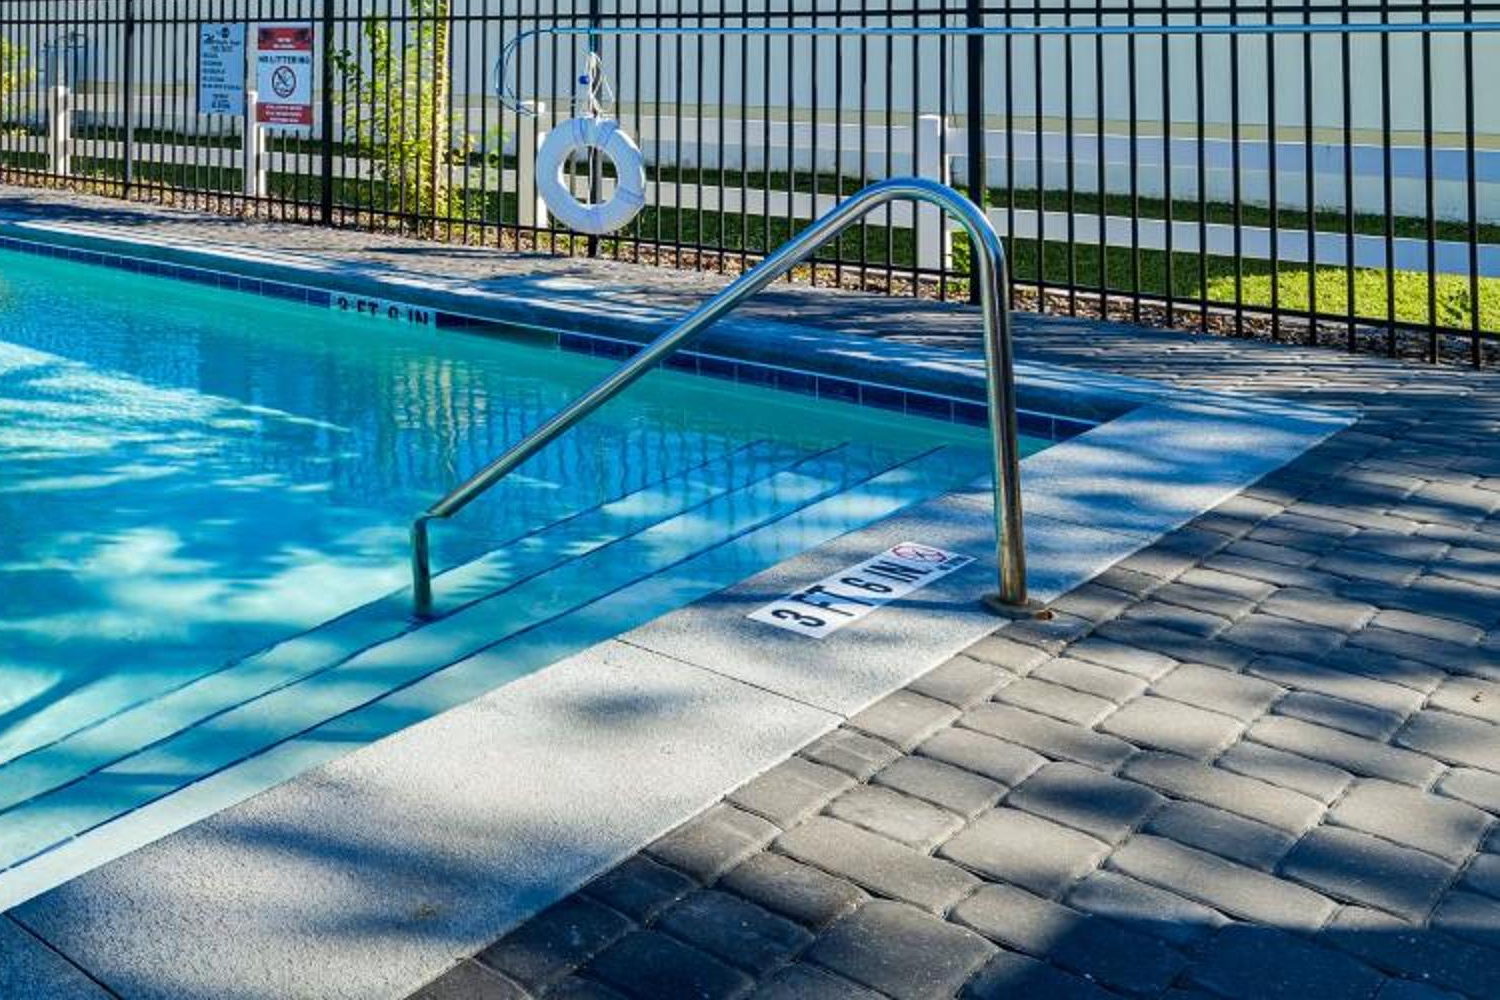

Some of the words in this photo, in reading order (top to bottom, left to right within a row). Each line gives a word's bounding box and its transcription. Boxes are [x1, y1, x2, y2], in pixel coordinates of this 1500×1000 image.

[408, 308, 429, 326] IN
[862, 559, 933, 583] IN
[839, 576, 893, 593] 6
[788, 584, 875, 617] FT
[771, 608, 827, 627] 3
